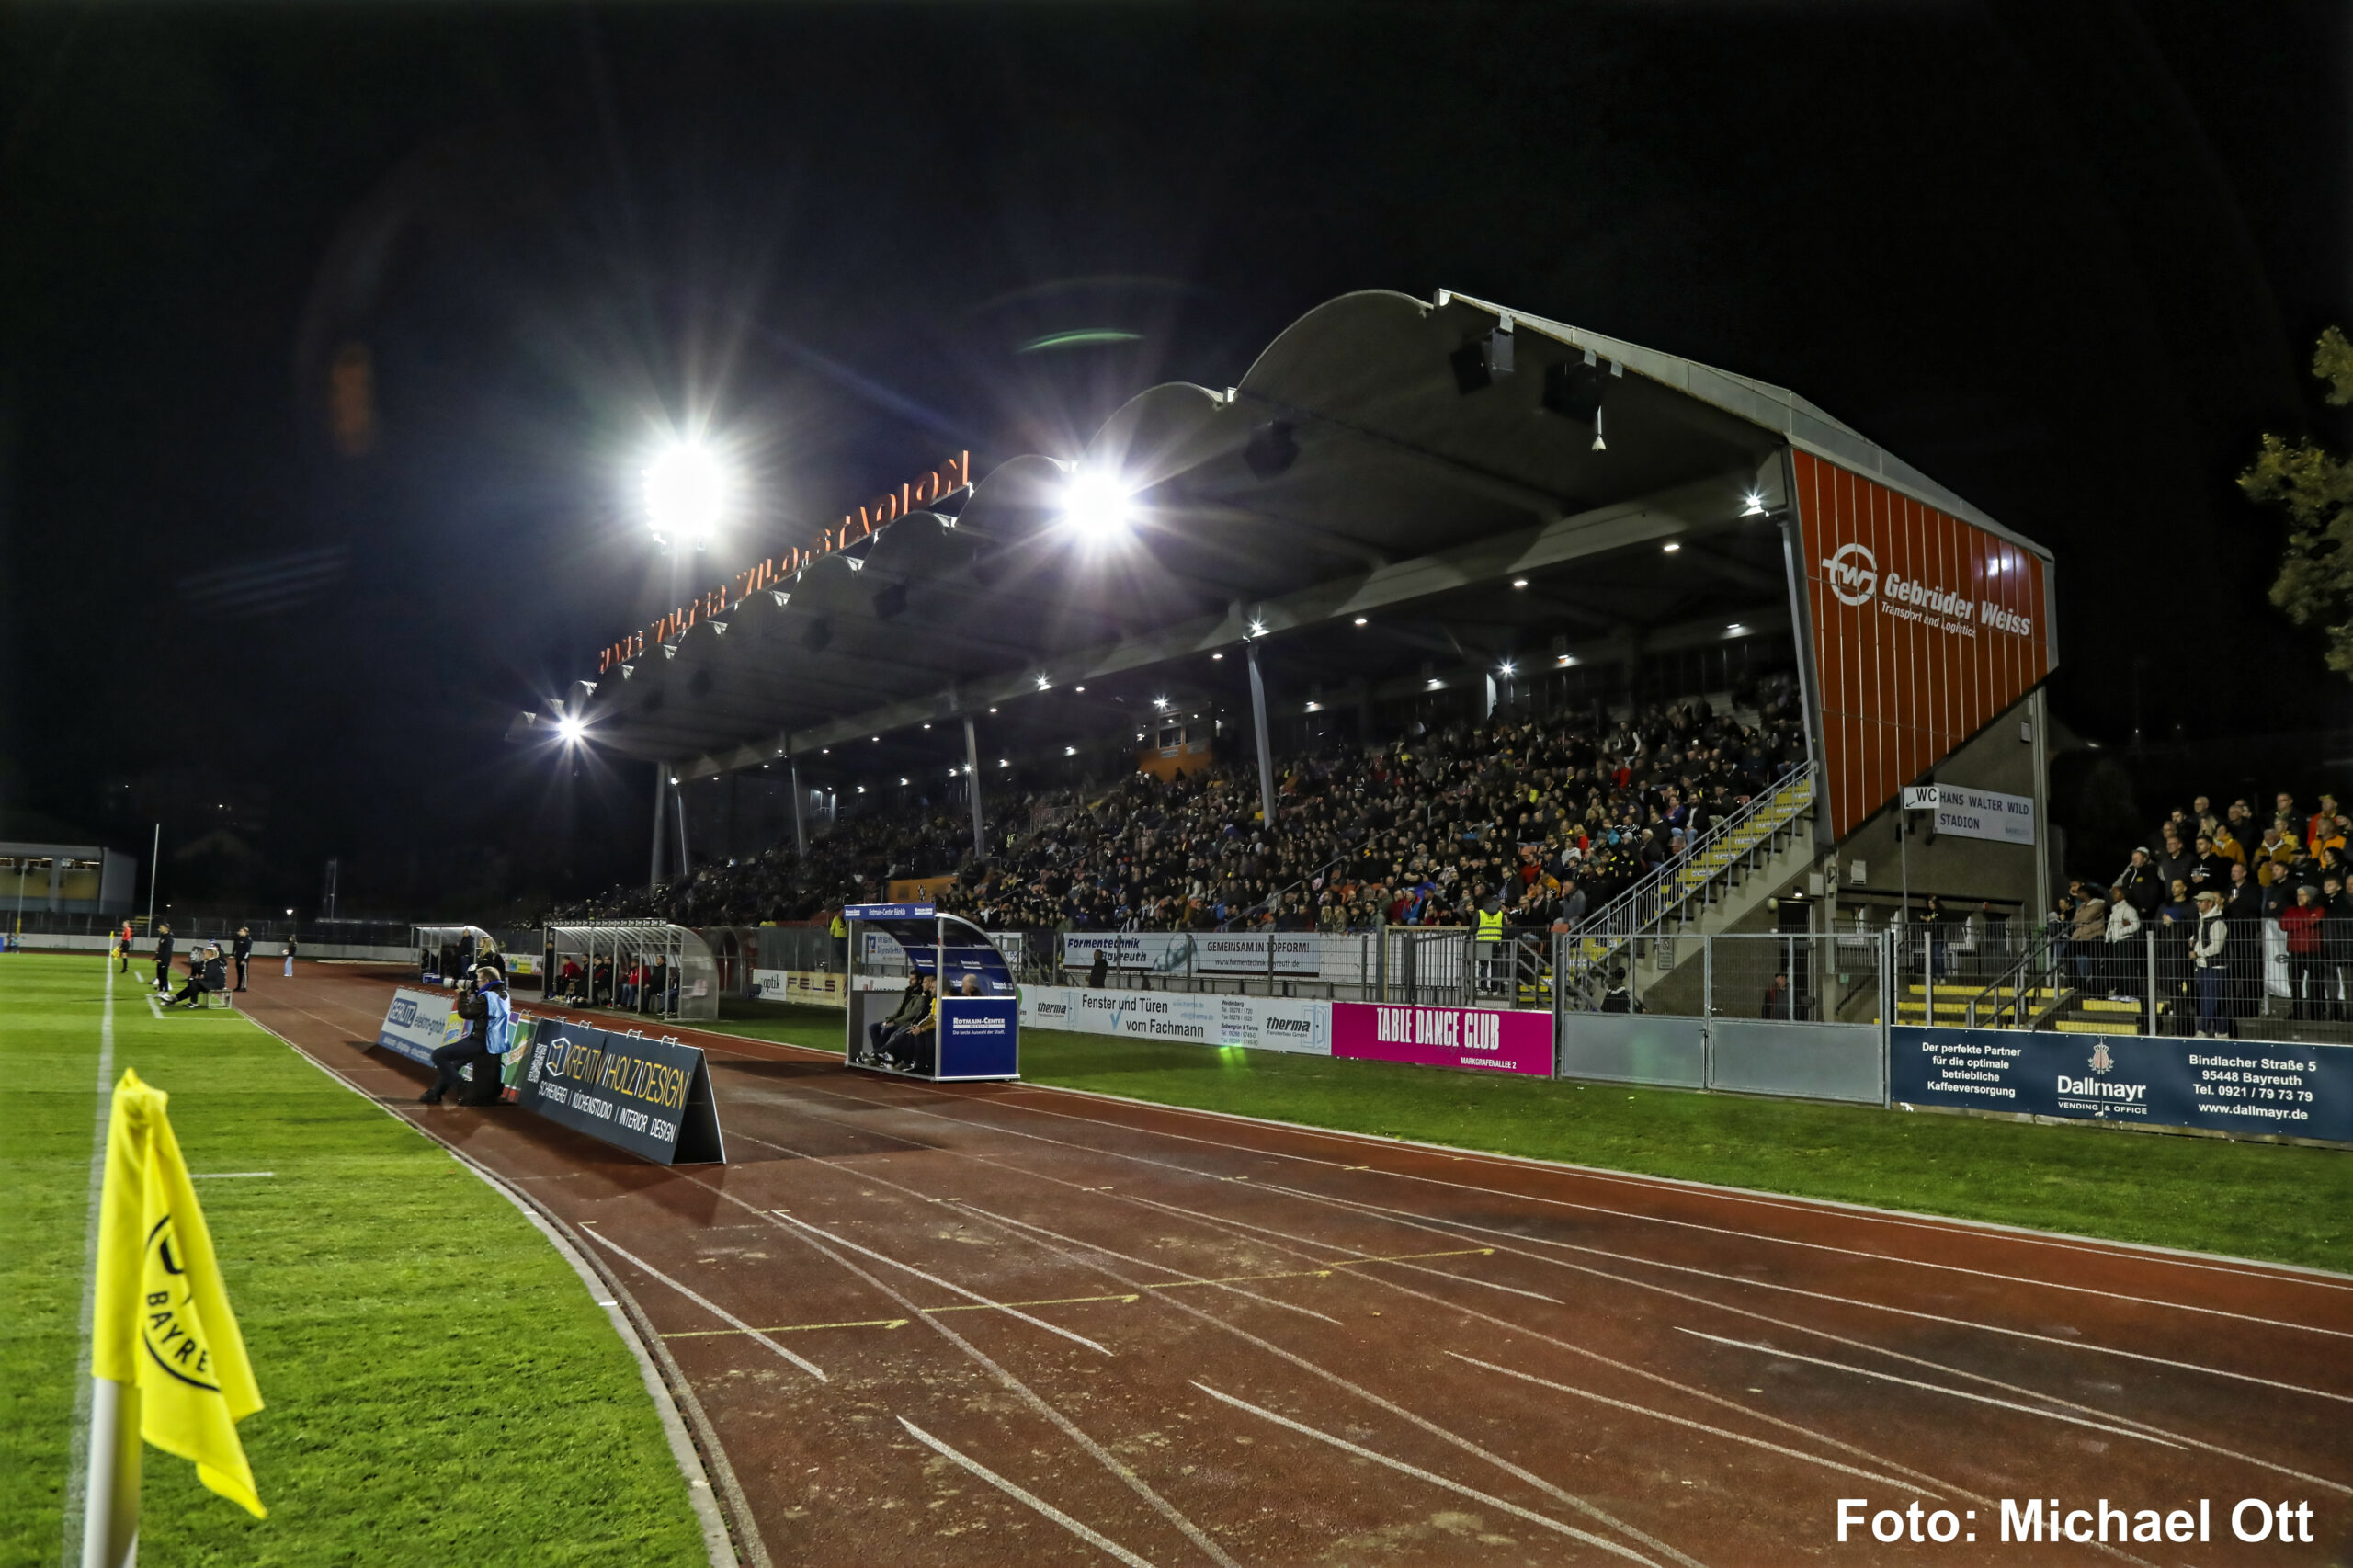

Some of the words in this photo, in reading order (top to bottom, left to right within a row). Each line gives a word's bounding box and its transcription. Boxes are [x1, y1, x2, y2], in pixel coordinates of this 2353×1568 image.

[1884, 572, 1974, 619] Gebrüder
[1981, 600, 2031, 636] Weiss
[1881, 601, 1922, 622] Transport
[1923, 613, 1940, 628] and
[1941, 618, 1976, 639] Logistics
[1916, 788, 1937, 802] WC
[1939, 791, 1964, 806] HANS
[1969, 795, 2003, 811] WALTER
[2007, 801, 2029, 815] WILD
[1940, 813, 1980, 829] STADION
[1207, 942, 1254, 952] GEMEINSAM
[1256, 942, 1265, 952] IN
[1037, 1002, 1067, 1014] therma
[1082, 994, 1116, 1010] Fenster
[1119, 997, 1137, 1011] und
[1139, 998, 1168, 1014] Türen
[1126, 1020, 1147, 1033] vom
[1150, 1019, 1204, 1038] Fachmann
[1266, 1016, 1310, 1033] therma
[1377, 1007, 1412, 1043] TABLE
[1416, 1009, 1459, 1047] DANCE
[1464, 1012, 1500, 1050] CLUB
[1922, 1042, 1939, 1051] Der
[1941, 1044, 1982, 1054] perfekte
[1984, 1046, 2022, 1057] Partner
[1461, 1057, 1511, 1068] MARKGRAFENALLEE
[1932, 1056, 1947, 1065] für
[1949, 1057, 1964, 1066] die
[1967, 1059, 2009, 1069] optimale
[2189, 1054, 2258, 1068] Bindlacher
[2261, 1058, 2304, 1071] Straße
[2308, 1061, 2316, 1071] 5
[1942, 1069, 2000, 1082] betriebliche
[2202, 1070, 2239, 1082] 95448
[2243, 1072, 2302, 1086] Bayreuth
[1927, 1081, 2015, 1098] Kaffeeversorgung
[2057, 1075, 2146, 1101] Dallmayr
[2193, 1084, 2214, 1095] Tel.
[2218, 1085, 2247, 1097] 0921
[2251, 1087, 2256, 1098] /
[2259, 1088, 2274, 1099] 79
[2278, 1090, 2294, 1101] 73
[2297, 1091, 2313, 1102] 79
[572, 1089, 613, 1120] KÜCHENSTUDIO
[619, 1109, 648, 1133] INTERIOR
[650, 1118, 676, 1143] DESIGN
[2058, 1102, 2099, 1111] VENDING
[2114, 1106, 2147, 1115] OFFICE
[2198, 1103, 2308, 1120] www.dallmayr.de
